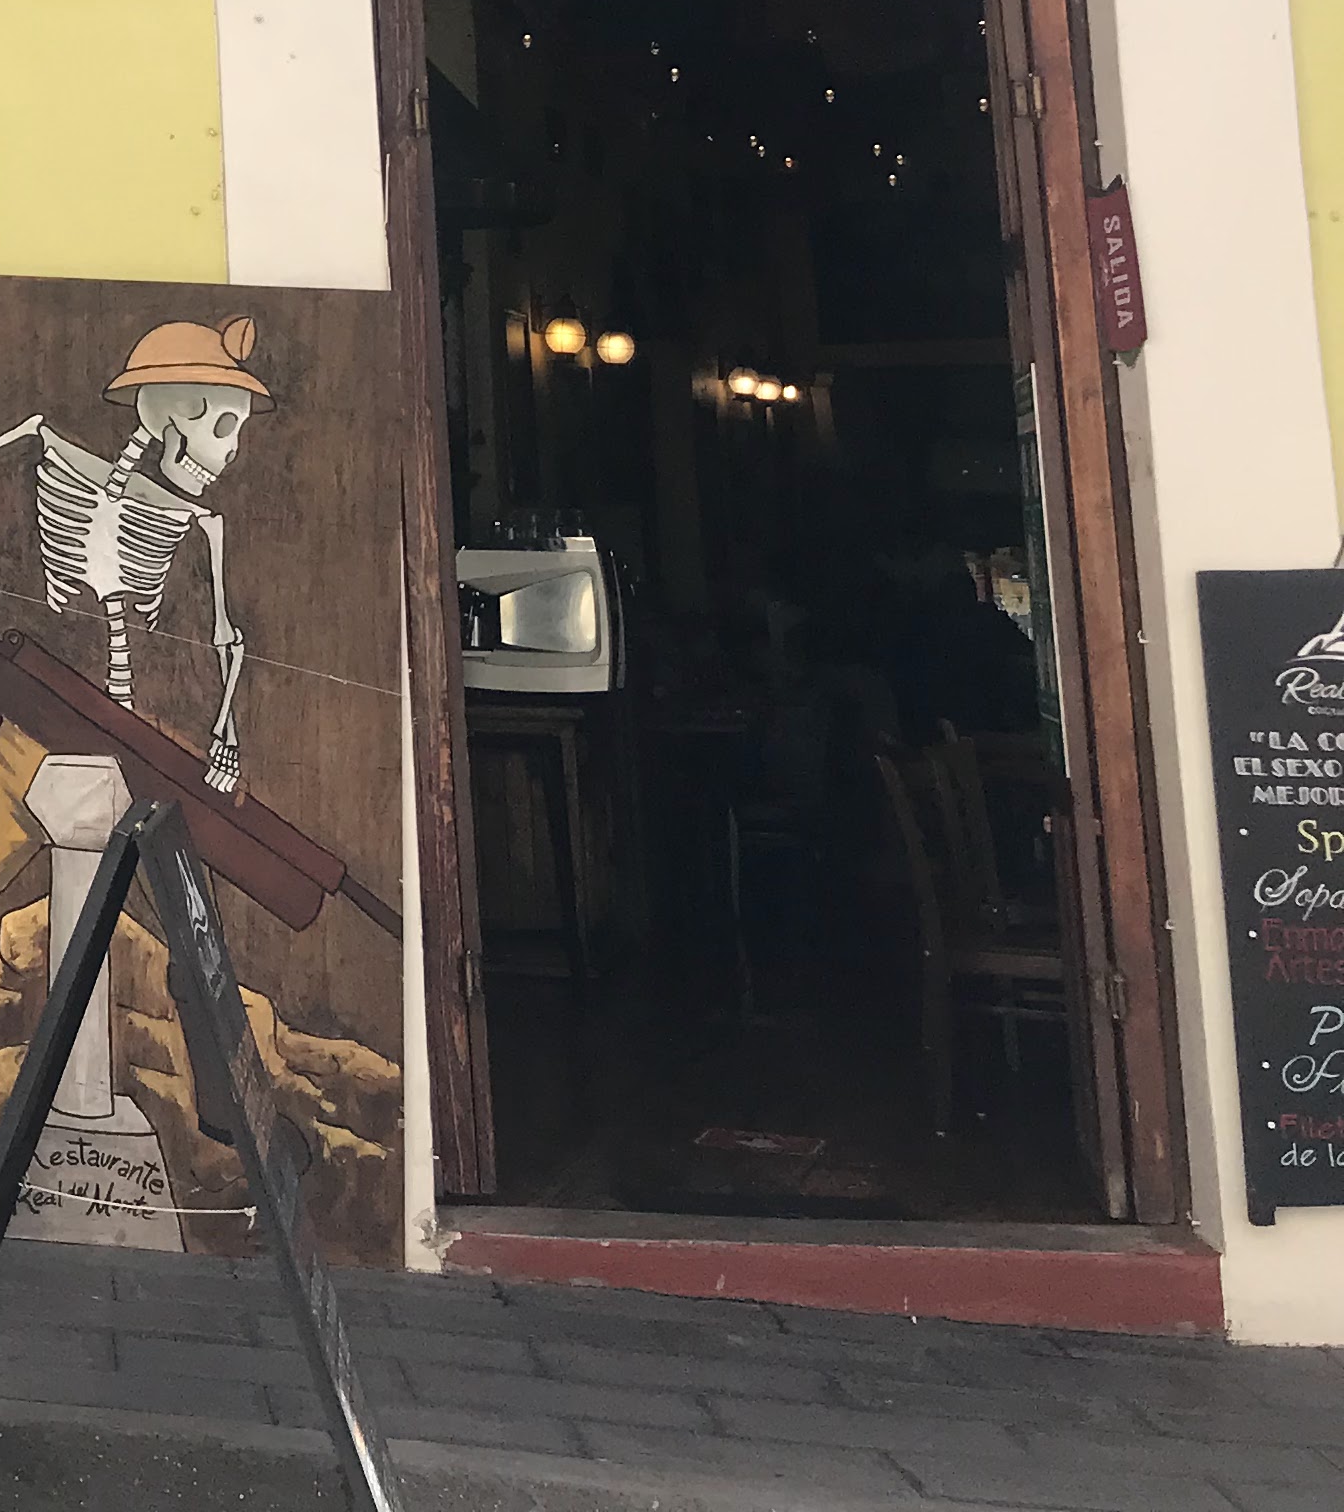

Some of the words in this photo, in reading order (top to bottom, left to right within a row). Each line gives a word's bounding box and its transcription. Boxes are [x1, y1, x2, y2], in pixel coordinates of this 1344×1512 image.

[1103, 214, 1134, 329] SALIDA
[1233, 756, 1268, 777] EL
[1270, 757, 1343, 778] SEXO
[1280, 1142, 1318, 1167] de
